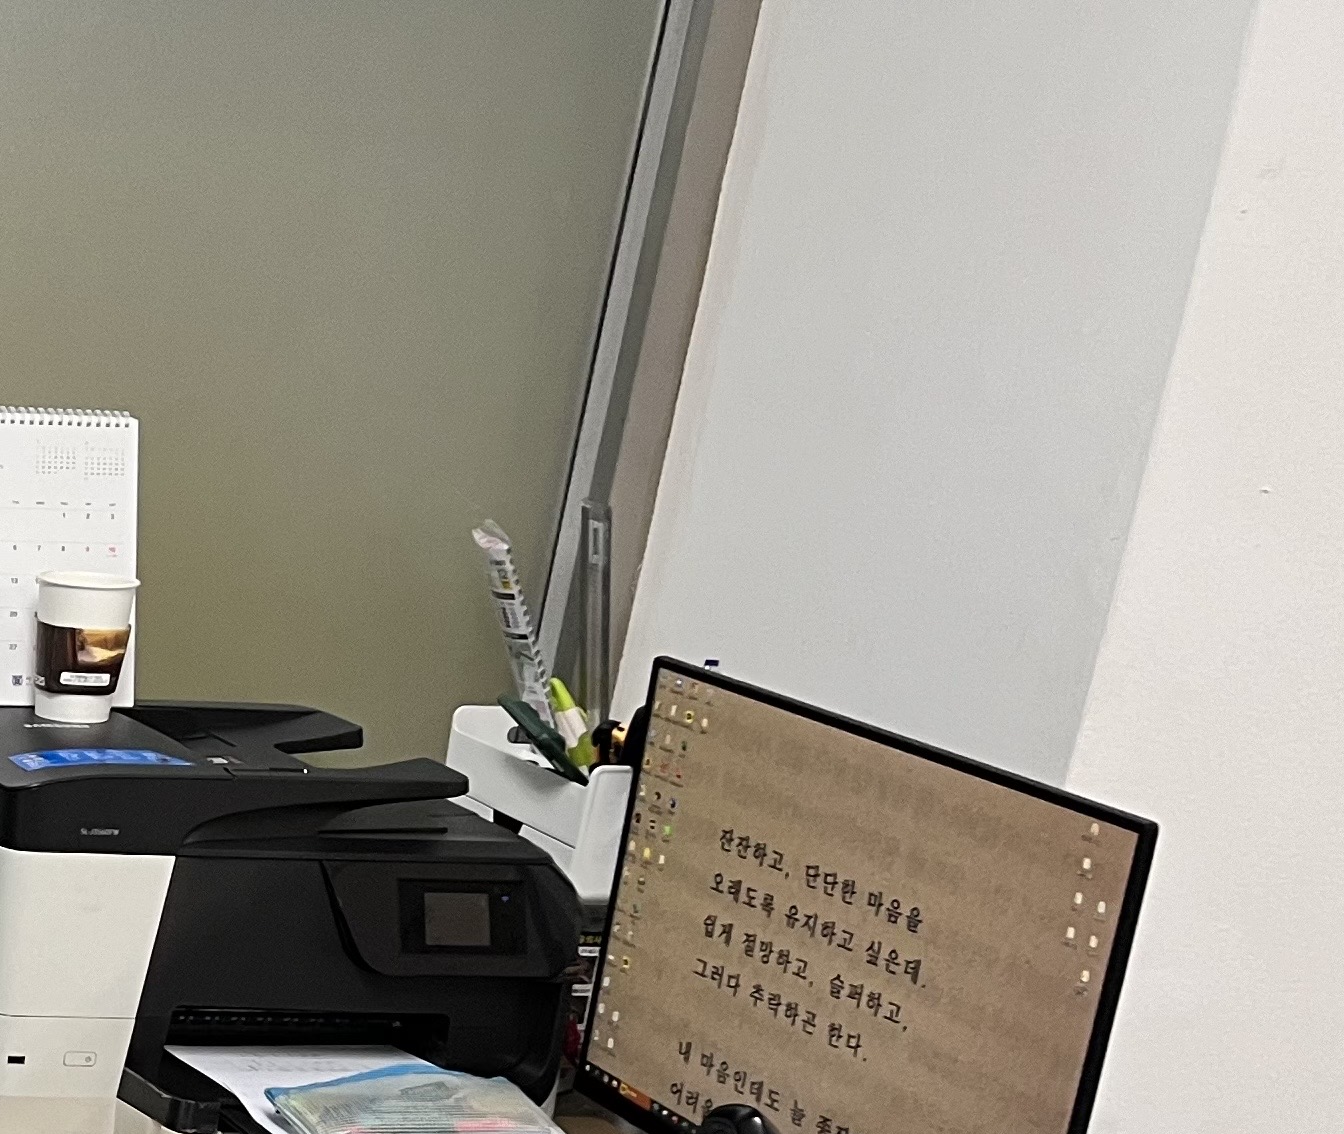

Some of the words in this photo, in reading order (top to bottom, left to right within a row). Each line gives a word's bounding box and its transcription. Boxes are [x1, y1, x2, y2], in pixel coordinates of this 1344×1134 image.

[710, 872, 775, 918] 오래도록
[785, 905, 854, 951] 유지하고
[720, 829, 790, 879] 잔잔하고,
[805, 864, 857, 905] 단단한
[867, 891, 923, 933] 마음을
[692, 958, 740, 997] 그러다
[749, 984, 817, 1035] 추락하곤
[827, 1022, 868, 1063] 한다.
[703, 914, 734, 947] 쉽게
[742, 933, 813, 987] 절망하고,
[829, 974, 908, 1033] 슬퍼하고,
[678, 1041, 693, 1065] 내
[701, 1051, 780, 1113] 마음인데도
[790, 1099, 806, 1128] 늘
